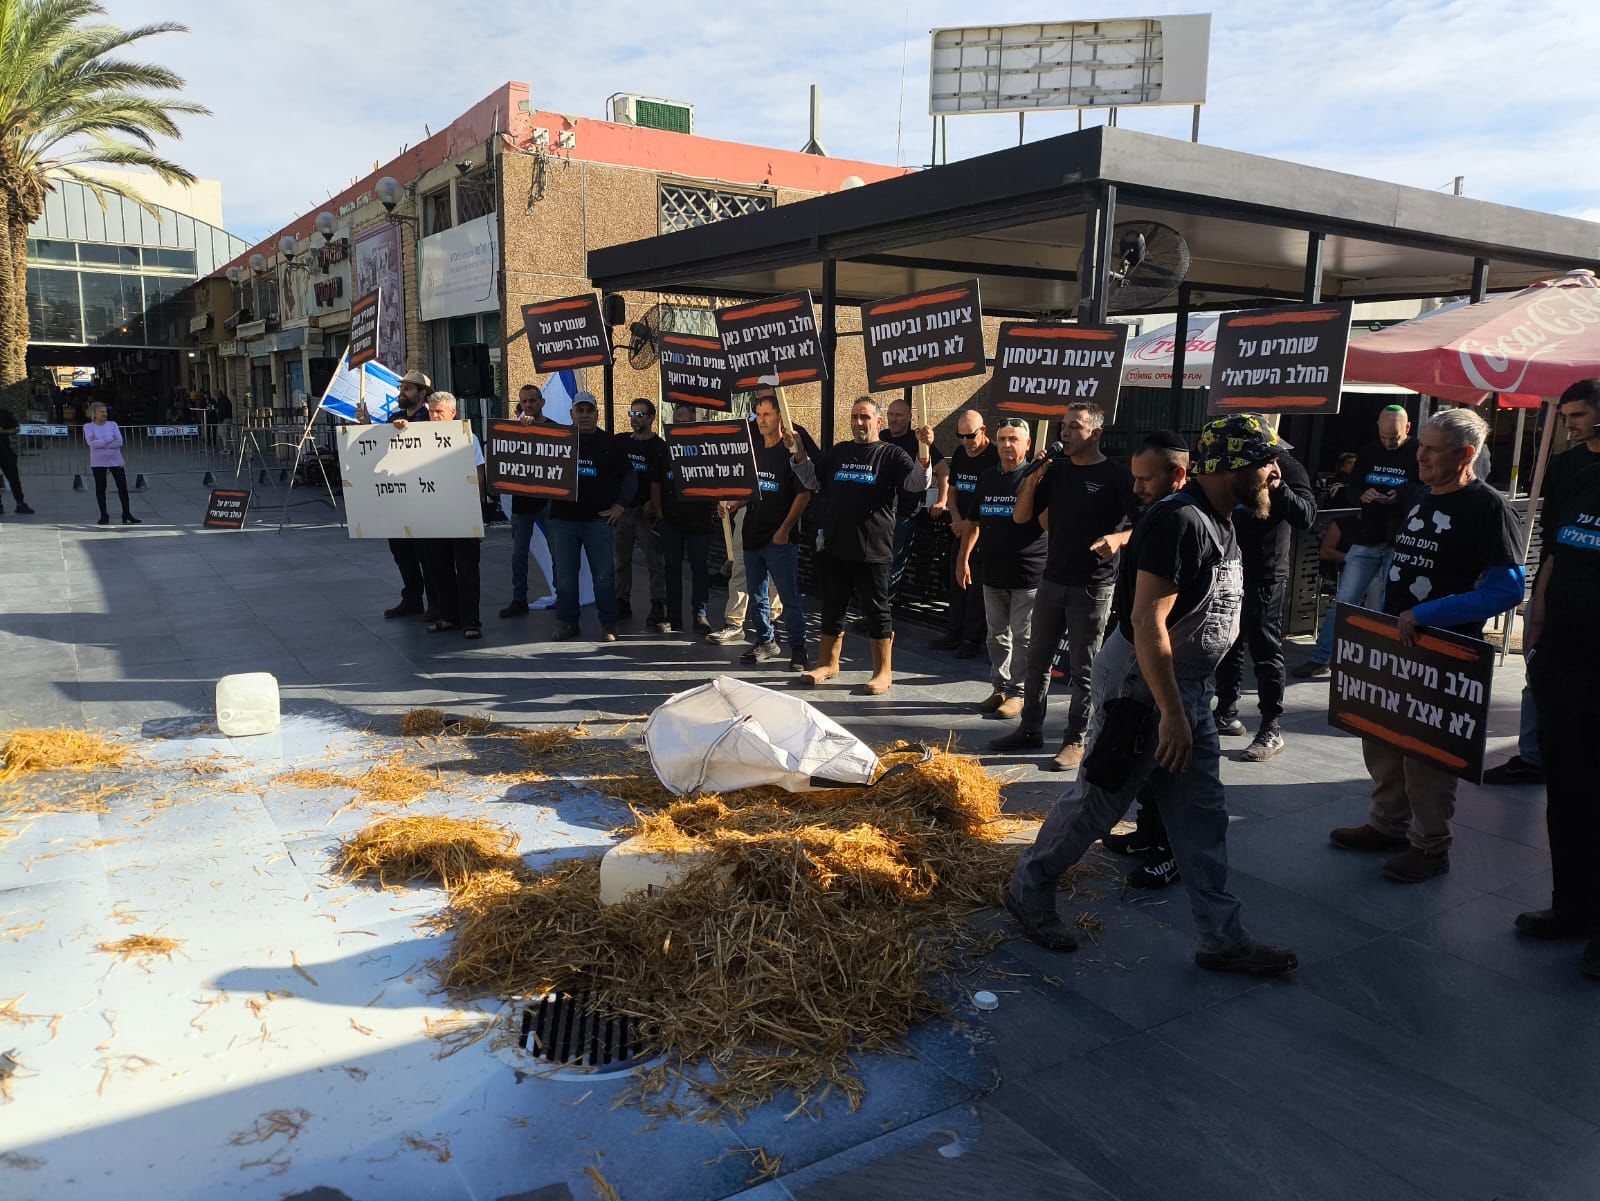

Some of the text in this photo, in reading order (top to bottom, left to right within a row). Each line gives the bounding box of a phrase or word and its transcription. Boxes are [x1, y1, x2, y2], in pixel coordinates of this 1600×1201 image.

[539, 316, 587, 334] שומרים על
[721, 316, 813, 350] חלב מייצרים כאן
[870, 306, 972, 346] ציונות וביטחון
[536, 332, 600, 355] החלב הישראלי
[882, 334, 964, 367] לא מייבאים
[1238, 335, 1319, 358] שומרים על
[686, 352, 701, 368] חלב
[704, 356, 726, 371] שותים
[727, 339, 815, 372] לא אצל ארדואן!
[1002, 347, 1115, 368] ציונות וביטחון
[697, 373, 708, 388] של
[708, 375, 722, 390] לא
[1221, 364, 1329, 387] החלב הישראלי
[1009, 376, 1099, 397] לא מייבאים
[390, 434, 422, 450] תשלח
[435, 432, 452, 448] אל
[492, 437, 572, 459] ציונות וביטחון
[699, 441, 719, 456] חלב
[720, 441, 749, 455] שותים
[499, 461, 563, 480] לא מייבאים
[716, 463, 729, 478] של
[733, 463, 744, 478] לא
[375, 477, 435, 497] אל הרפתן
[1576, 512, 1594, 524] על
[1417, 538, 1439, 552] העם
[1562, 528, 1600, 547] שראלי!
[1410, 554, 1434, 569] חלב
[1336, 637, 1484, 704] חלב מייצרים כאן
[1337, 670, 1476, 740] לא אצל ארדואן!
